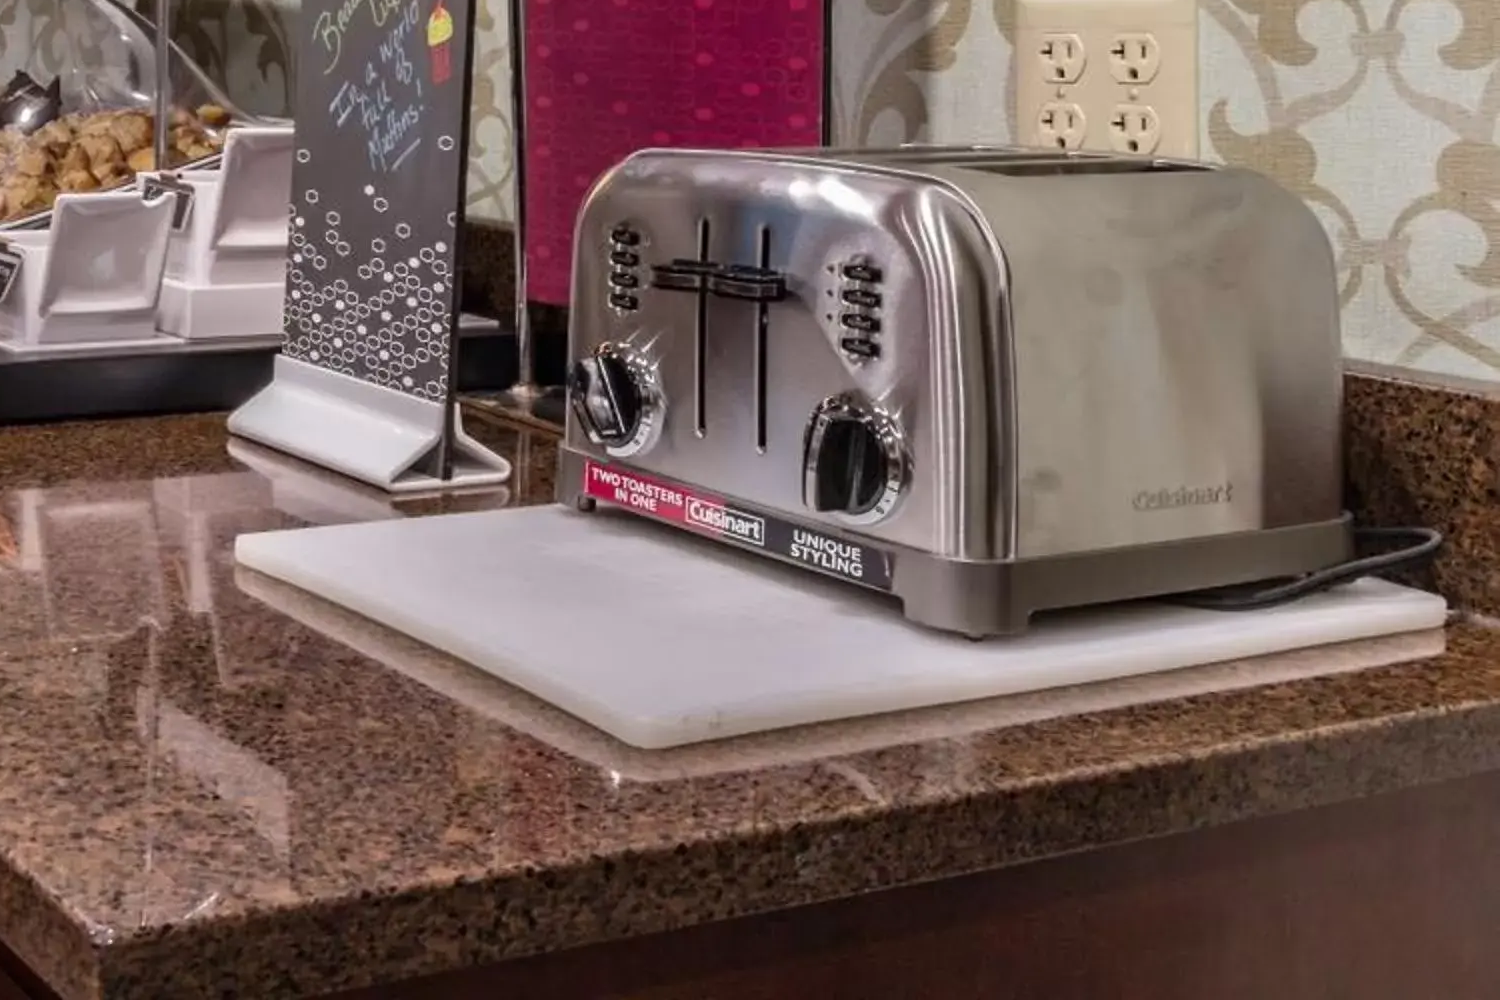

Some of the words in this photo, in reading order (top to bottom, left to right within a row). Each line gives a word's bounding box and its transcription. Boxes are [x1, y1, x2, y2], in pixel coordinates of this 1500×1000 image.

[591, 466, 621, 488] TWO
[620, 475, 683, 507] TOASTERS
[614, 487, 627, 502] IN
[629, 491, 657, 512] ONE
[688, 500, 761, 540] Cuisinart
[790, 543, 863, 578] STYLING
[792, 529, 862, 561] UNIQUE
